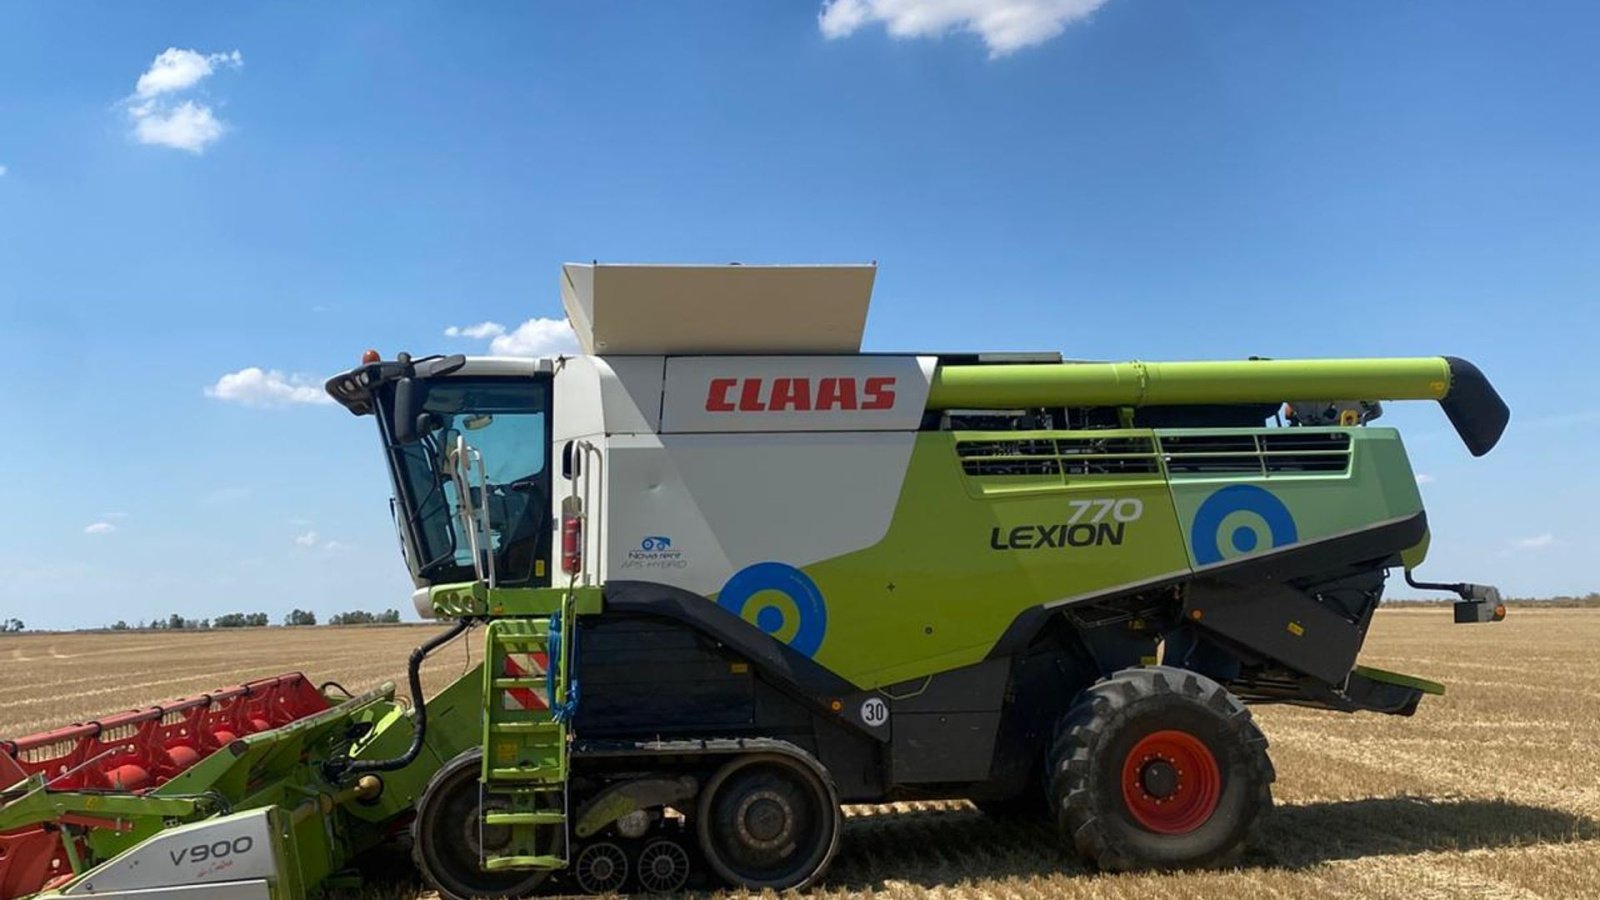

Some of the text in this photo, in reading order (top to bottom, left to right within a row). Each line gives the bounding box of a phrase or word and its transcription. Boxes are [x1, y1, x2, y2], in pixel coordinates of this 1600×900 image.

[705, 377, 897, 411] CLAAS
[1067, 498, 1144, 524] 770
[990, 522, 1125, 550] LEXION
[865, 703, 884, 721] 30
[170, 836, 253, 866] V900
